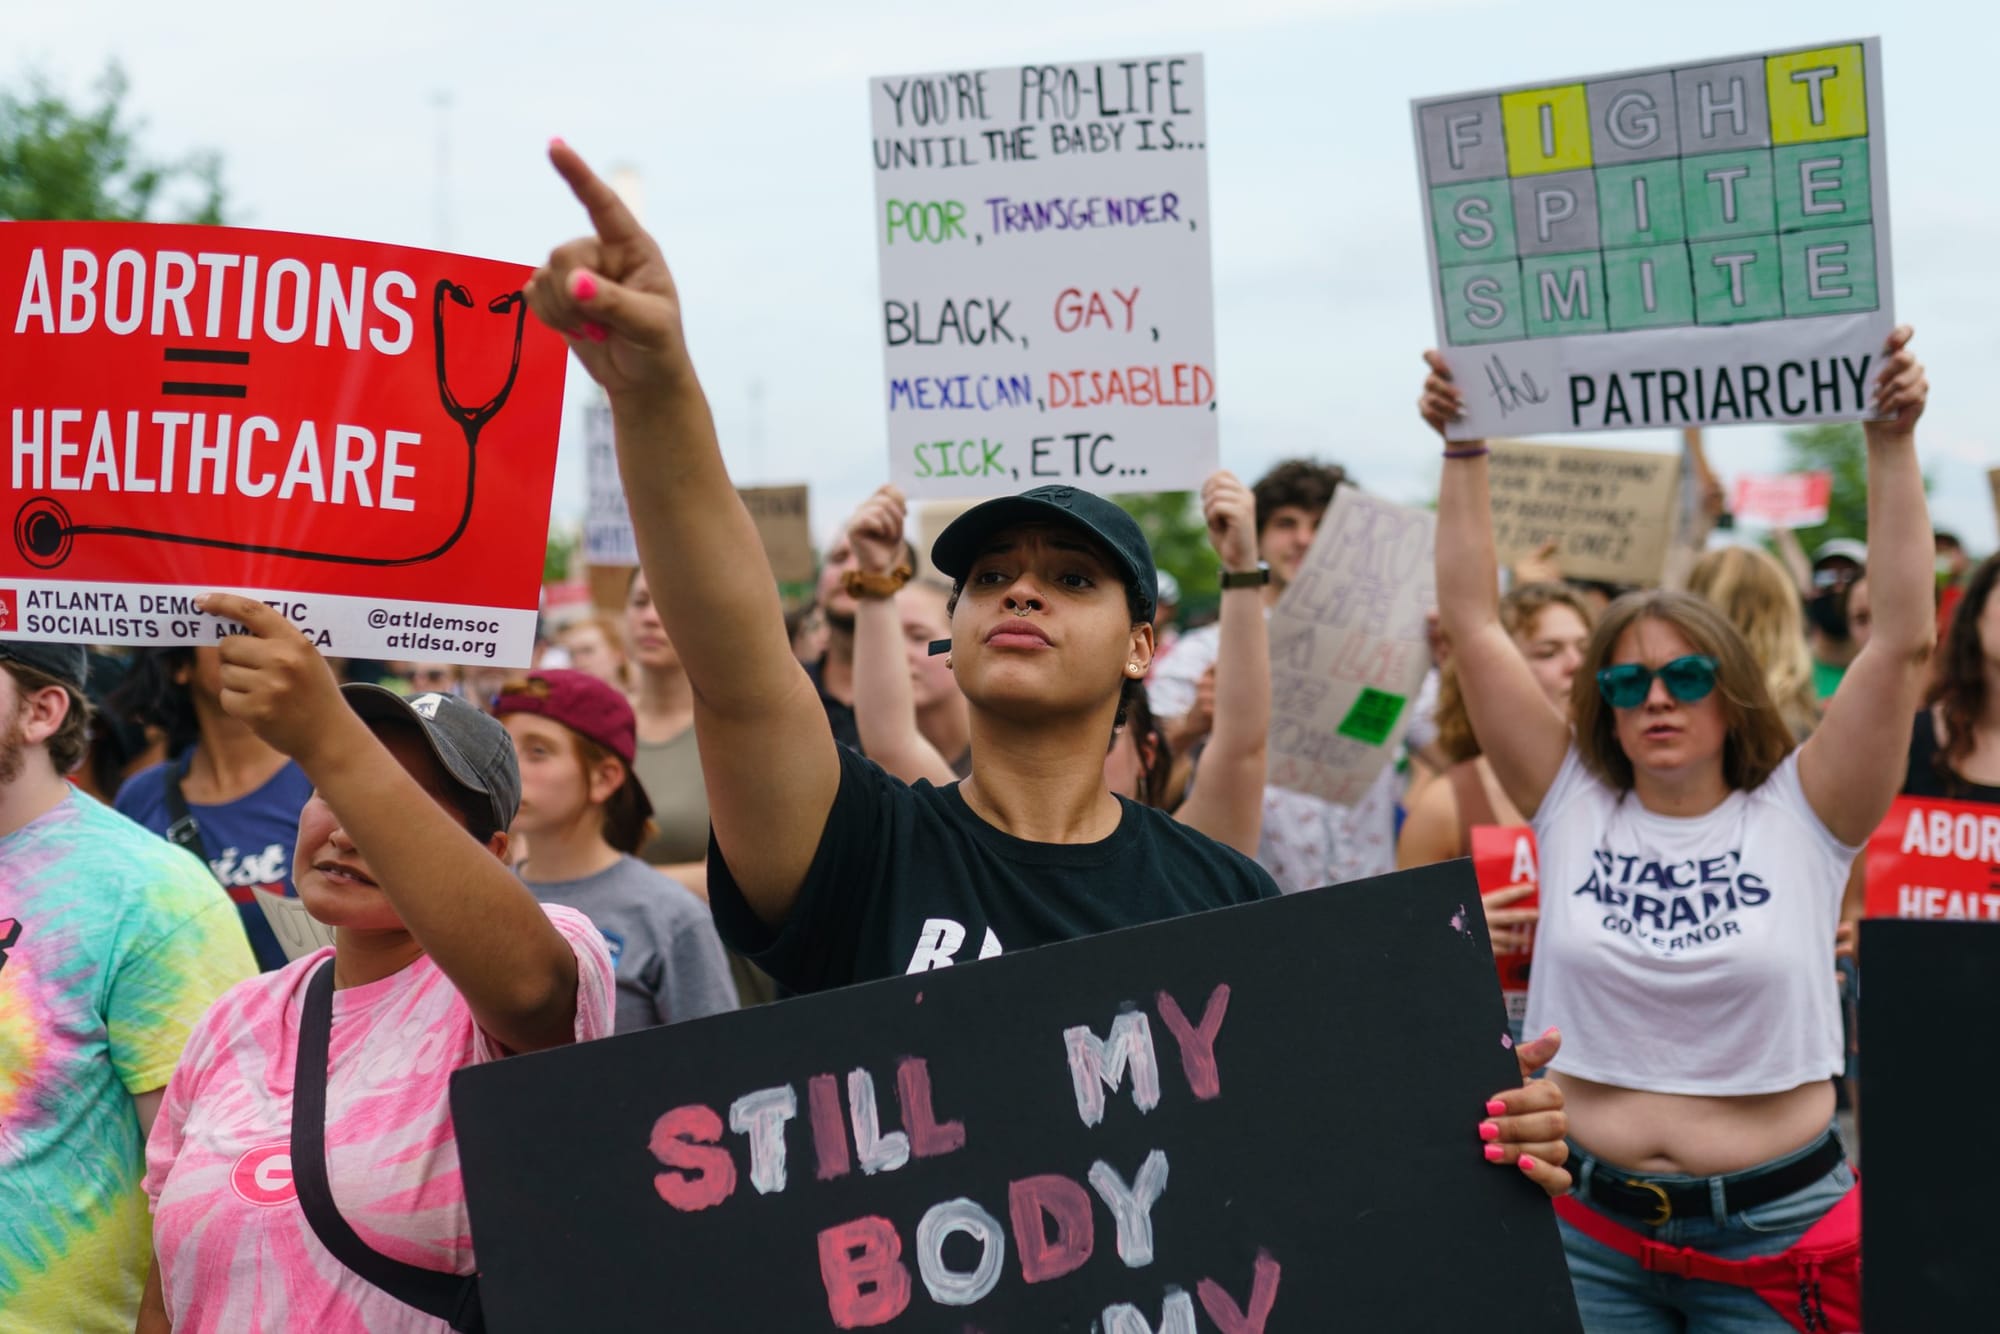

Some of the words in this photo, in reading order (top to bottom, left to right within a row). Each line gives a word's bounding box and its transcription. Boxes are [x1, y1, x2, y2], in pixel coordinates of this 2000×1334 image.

[883, 70, 991, 128] YOU'RE
[1019, 59, 1192, 122] PRO-LIFE
[1446, 65, 1837, 170] FIGHT
[872, 137, 978, 170] UNTIL
[982, 125, 1038, 161] THE
[1050, 122, 1125, 155] BABY
[1454, 156, 1846, 250] SPITE
[14, 247, 417, 356] ABORTIONS
[1464, 243, 1853, 330] SMITE
[1484, 352, 1549, 420] the
[1568, 353, 1871, 426] PATRIARCHY
[11, 408, 422, 513] HEALTHCARE
[26, 590, 128, 613] ATLANTA
[27, 614, 159, 638] SOCIALISTS
[171, 621, 201, 638] OF
[368, 608, 500, 634] @atldemsoc
[387, 633, 497, 658] atldsa.org
[649, 1056, 965, 1212] STILL
[1062, 983, 1230, 1128] MY
[817, 1149, 1169, 1329] BODY
